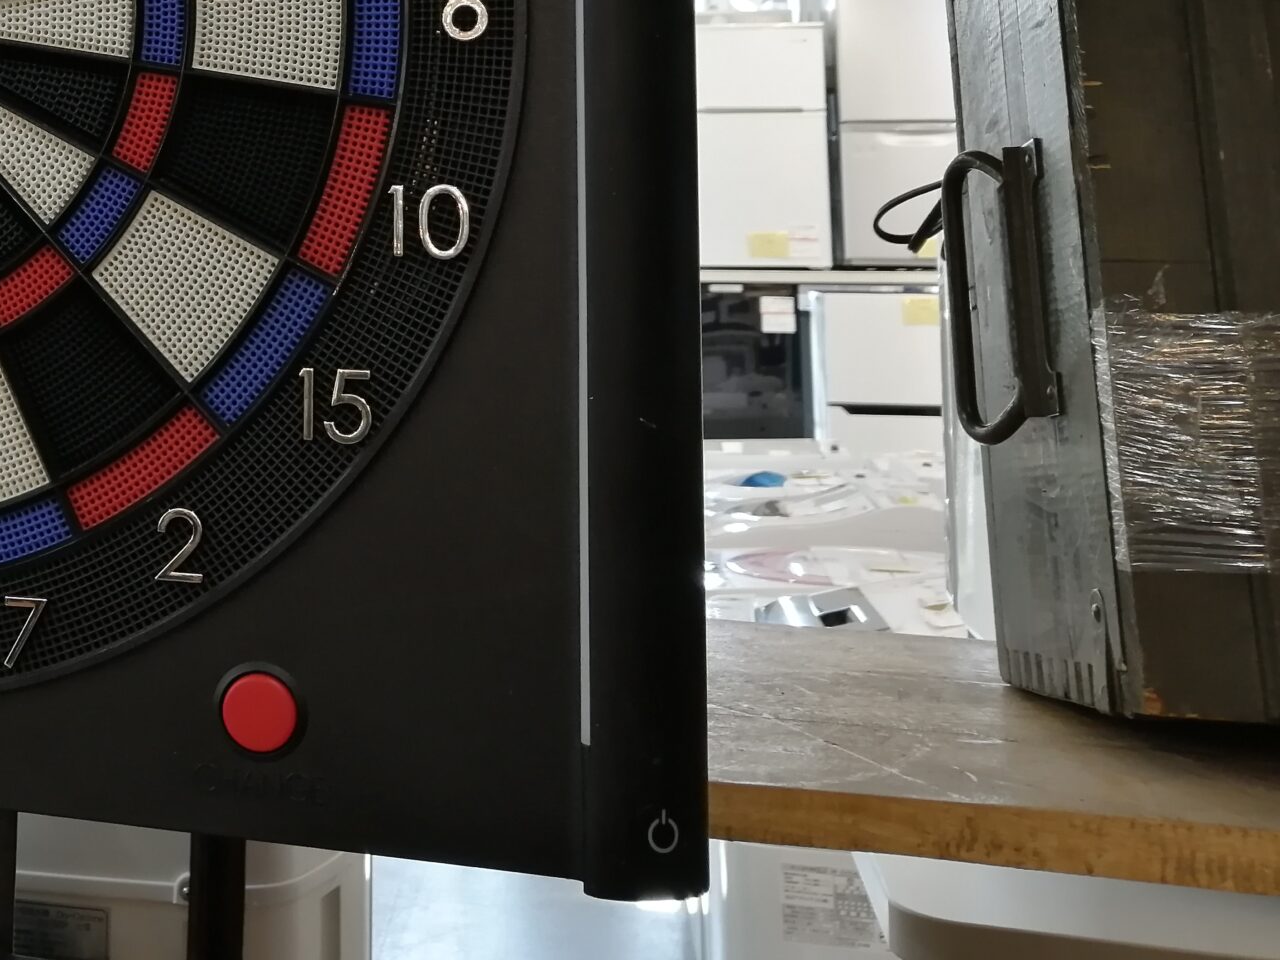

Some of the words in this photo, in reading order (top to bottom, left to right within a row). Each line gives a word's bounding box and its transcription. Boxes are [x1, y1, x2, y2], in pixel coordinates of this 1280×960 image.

[388, 183, 470, 260] 10
[298, 367, 373, 445] 15
[154, 507, 204, 584] 2
